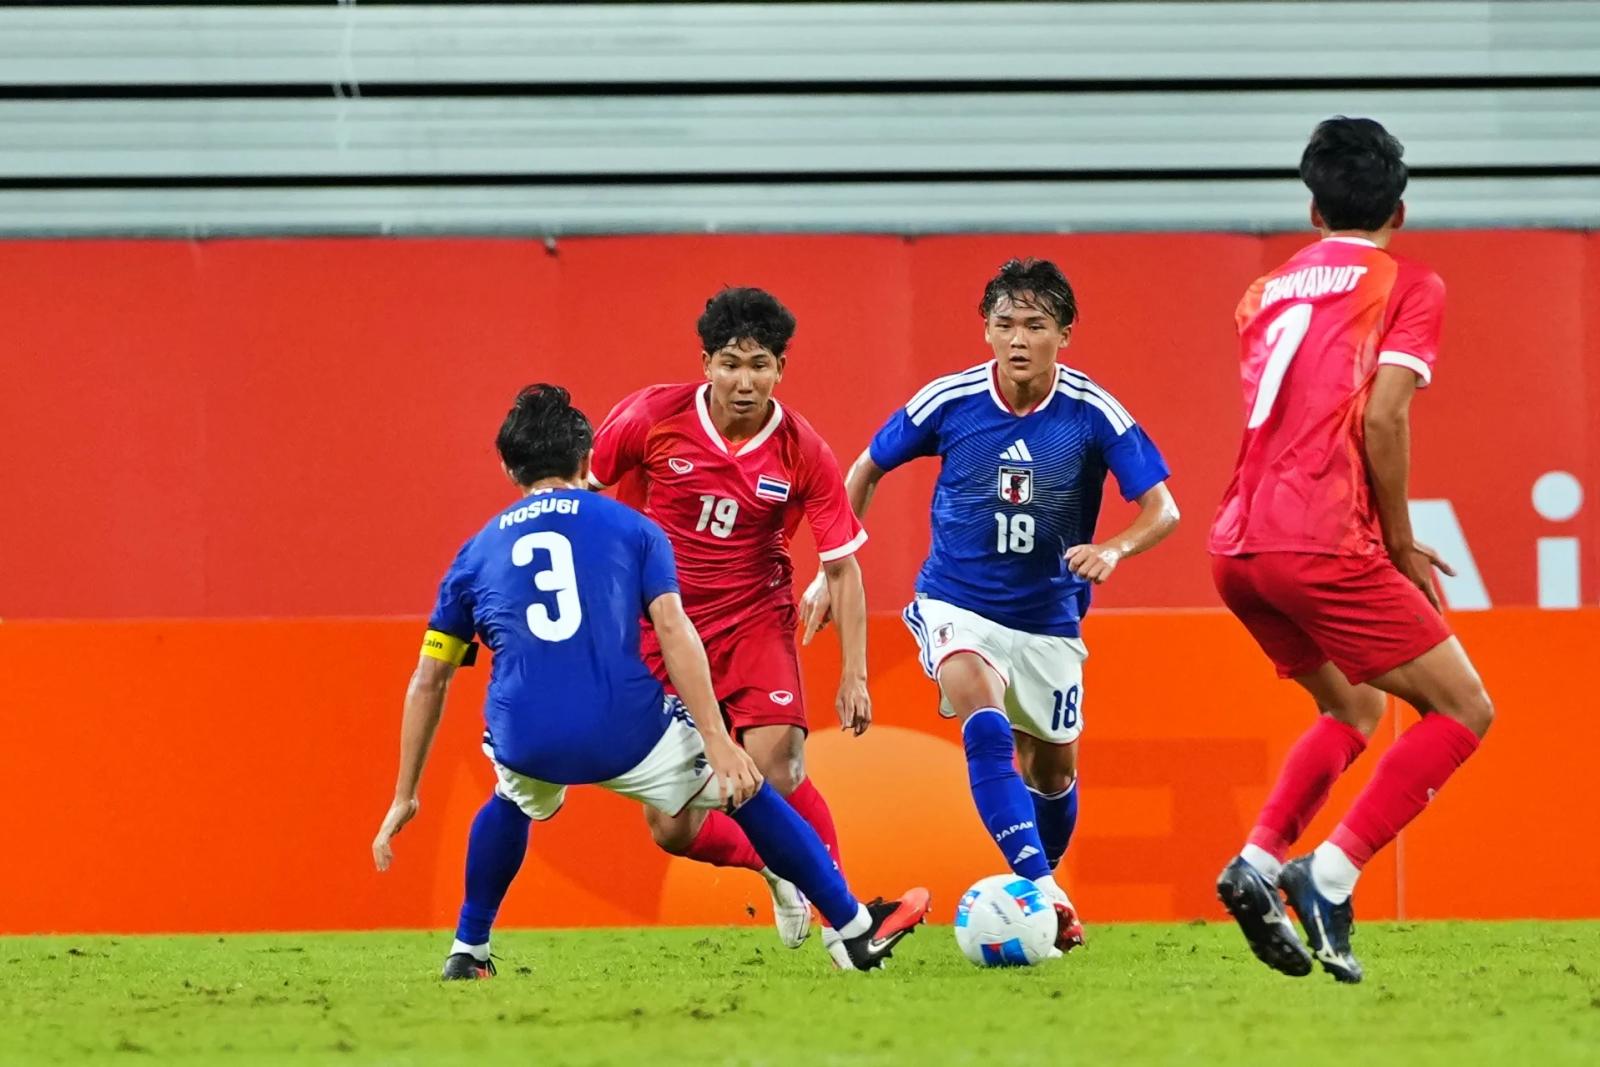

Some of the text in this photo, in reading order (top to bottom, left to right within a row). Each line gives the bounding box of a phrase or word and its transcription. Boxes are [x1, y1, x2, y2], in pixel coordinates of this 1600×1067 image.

[1248, 303, 1313, 428] 7
[499, 497, 580, 530] KOSUGI
[695, 495, 739, 538] 19
[994, 512, 1036, 554] 18
[511, 531, 582, 642] 3
[1051, 685, 1080, 731] 18
[996, 820, 1034, 842] JAPAN
